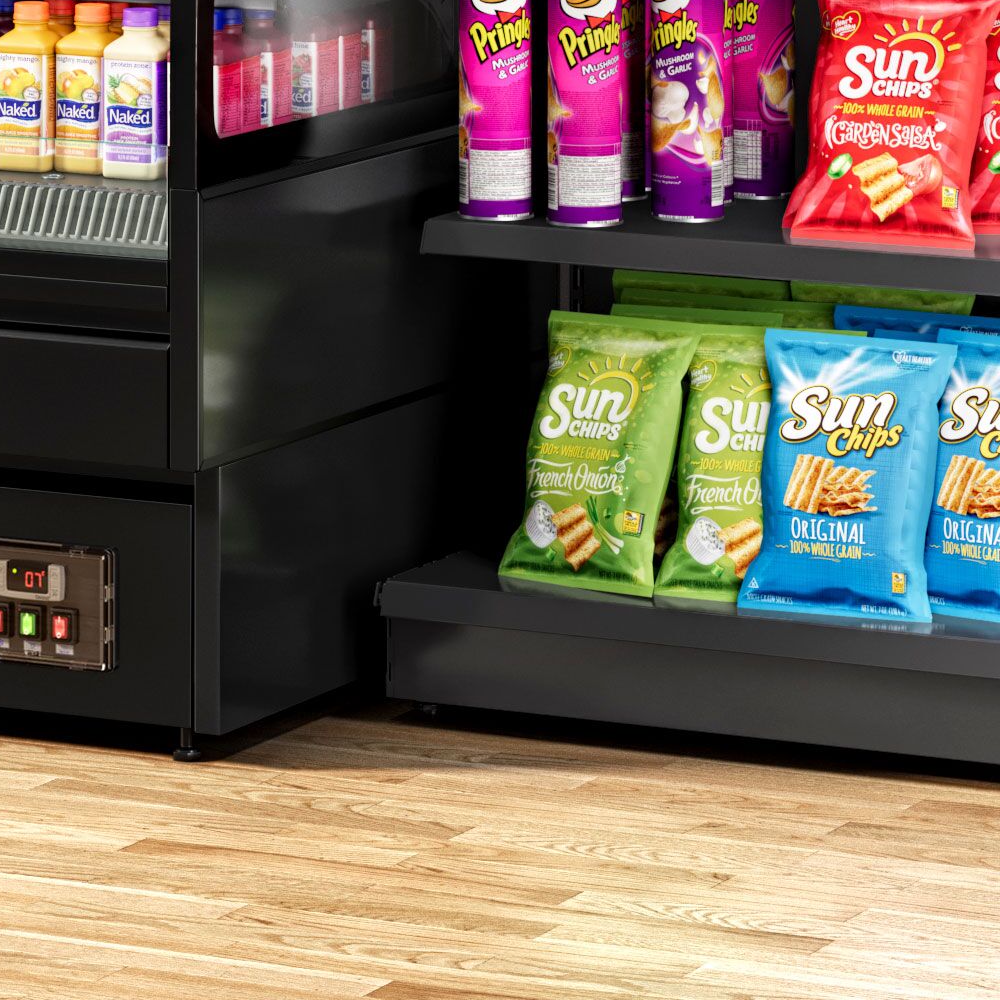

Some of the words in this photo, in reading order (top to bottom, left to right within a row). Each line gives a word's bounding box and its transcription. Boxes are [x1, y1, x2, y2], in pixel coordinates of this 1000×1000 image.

[834, 16, 852, 26] Heart
[469, 10, 530, 63] Pringles
[558, 14, 620, 69] Pringles
[111, 62, 131, 70] protein
[655, 52, 694, 69] MUSHROOM
[499, 70, 507, 79] &
[659, 70, 666, 79] &
[667, 62, 692, 76] GARLIC
[839, 45, 944, 99] Sun
[588, 75, 597, 85] &
[872, 81, 933, 98] CHIPS
[57, 104, 95, 119] Naked
[110, 109, 151, 124] Naked
[843, 103, 865, 114] 100%
[867, 103, 896, 116] WHOLE
[897, 105, 924, 118] GRAIN
[539, 383, 637, 440] Sun
[780, 385, 897, 442] Sun
[569, 422, 622, 441] CHIPS
[826, 424, 903, 458] Chips
[541, 443, 560, 455] 100%
[560, 446, 587, 459] WHOLE
[587, 449, 610, 461] GRAIN
[699, 458, 721, 470] 100%
[725, 460, 753, 473] WHOLE
[528, 459, 573, 490] French
[574, 464, 621, 495] Onion
[686, 474, 742, 509] French
[791, 517, 866, 545] ORIGINAL
[790, 541, 811, 554] 100%
[811, 543, 835, 556] WHOLE
[836, 544, 862, 559] GRAIN
[942, 541, 960, 554] 100%
[961, 543, 981, 557] WHOLE
